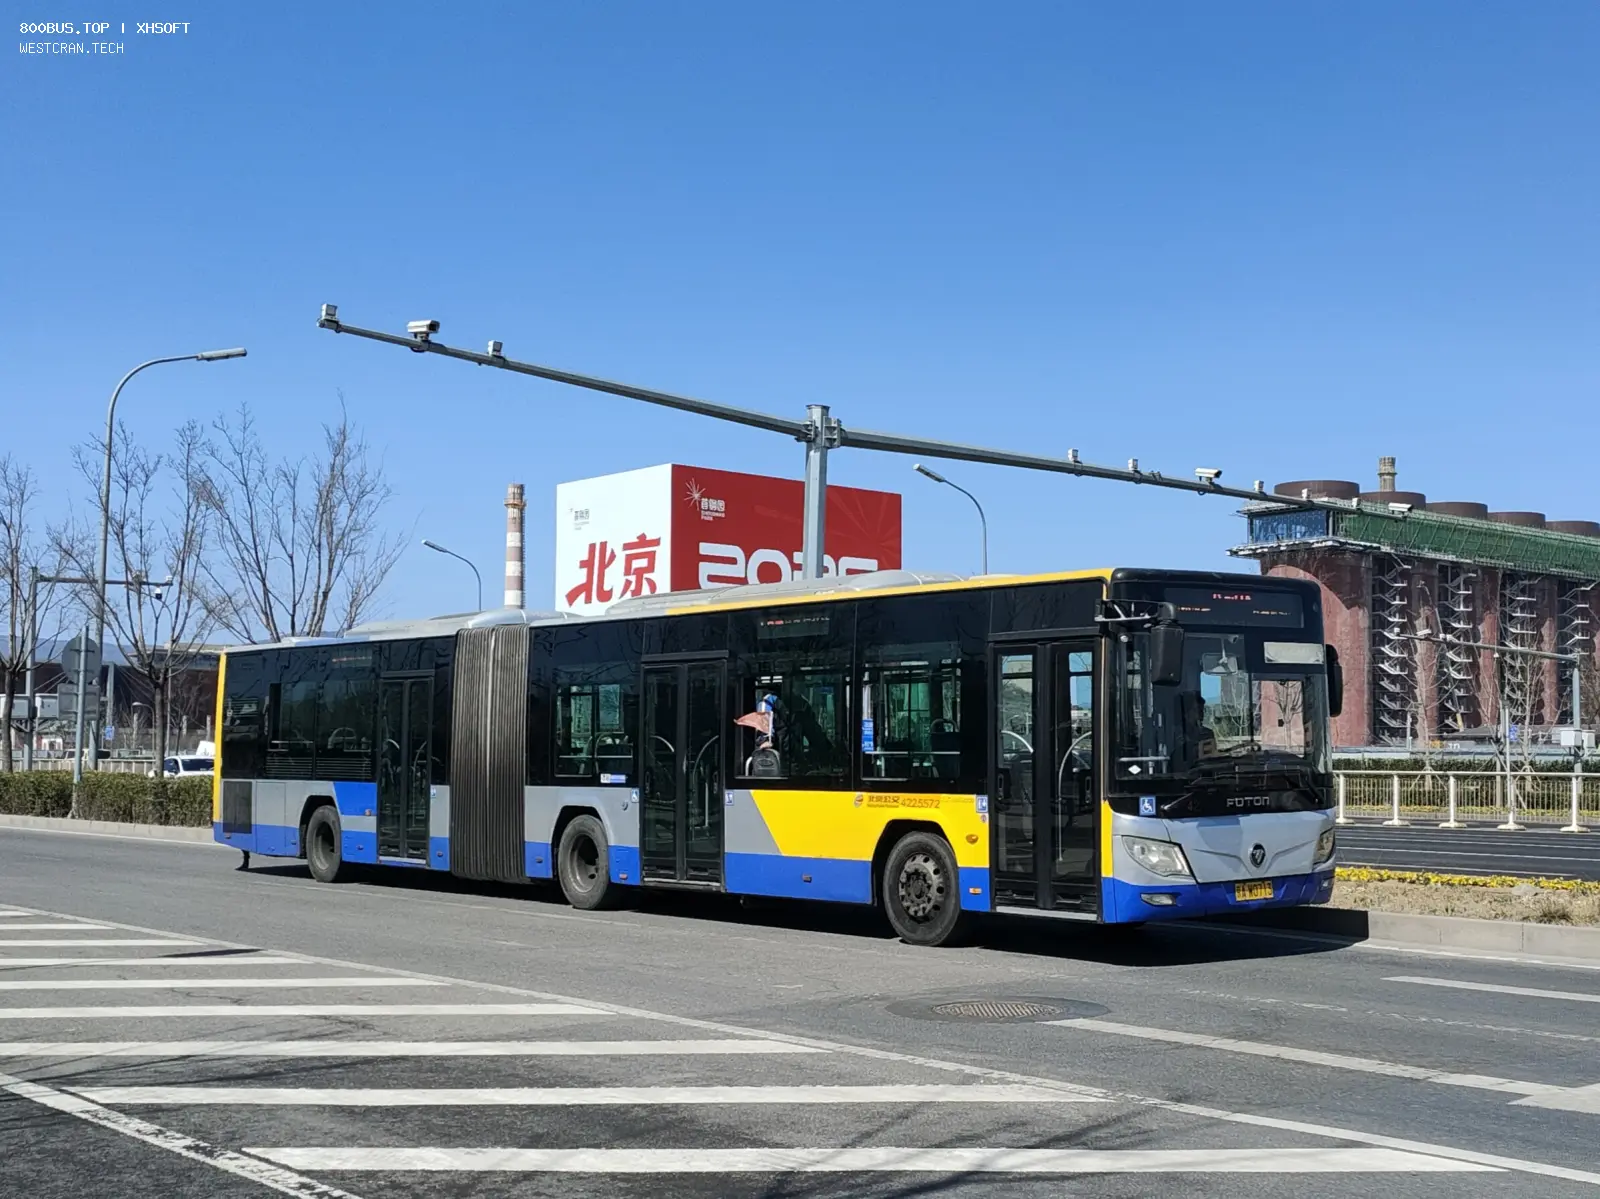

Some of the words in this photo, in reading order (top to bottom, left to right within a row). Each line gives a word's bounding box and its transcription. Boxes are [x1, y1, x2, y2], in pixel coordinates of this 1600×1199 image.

[565, 533, 661, 607] 北京
[901, 799, 941, 809] 4225572
[1226, 796, 1270, 808] FOTON
